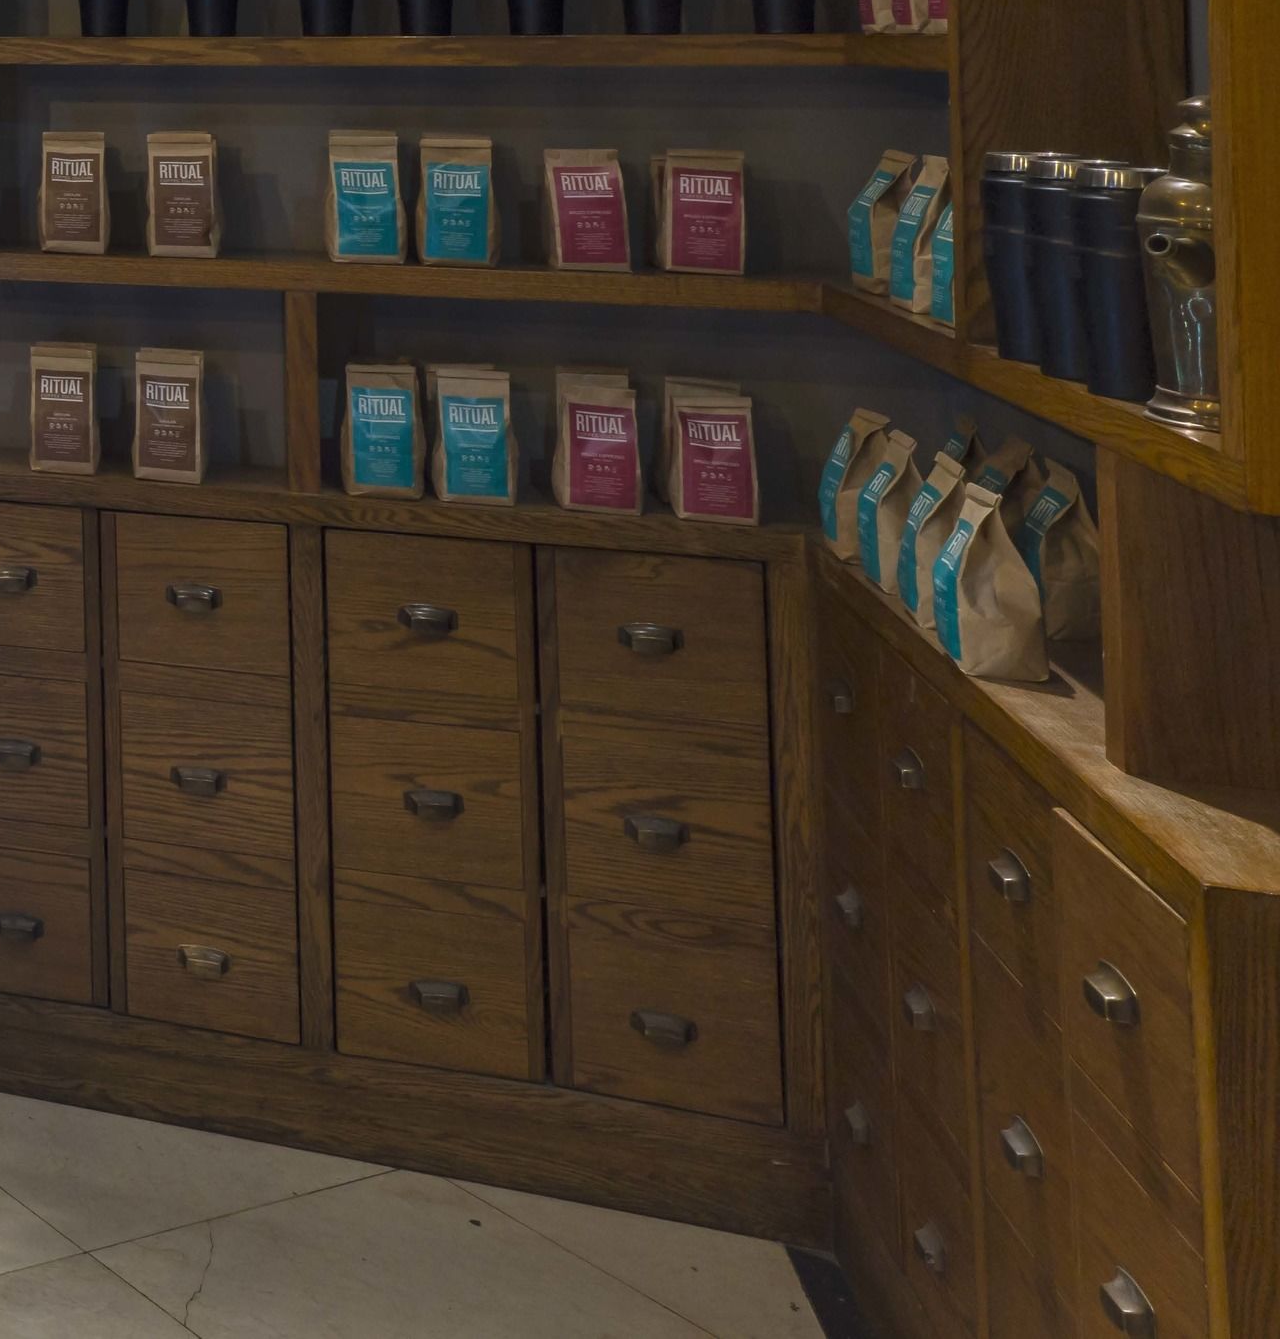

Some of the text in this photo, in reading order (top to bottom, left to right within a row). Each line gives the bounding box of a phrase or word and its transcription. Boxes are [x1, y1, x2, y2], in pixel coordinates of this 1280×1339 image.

[51, 160, 93, 176] RITUAL
[159, 164, 203, 179] RITUAL
[341, 171, 388, 188] RITUAL
[433, 173, 481, 189] RITUAL
[561, 175, 613, 191] RITUAL
[680, 177, 733, 196] RITUAL
[40, 378, 83, 396] RITUAL
[145, 383, 189, 403] RITUAL
[358, 397, 406, 417] RITUAL
[449, 406, 497, 426] RITUAL
[576, 413, 626, 435] RITUAL
[688, 422, 741, 443] RITUAL
